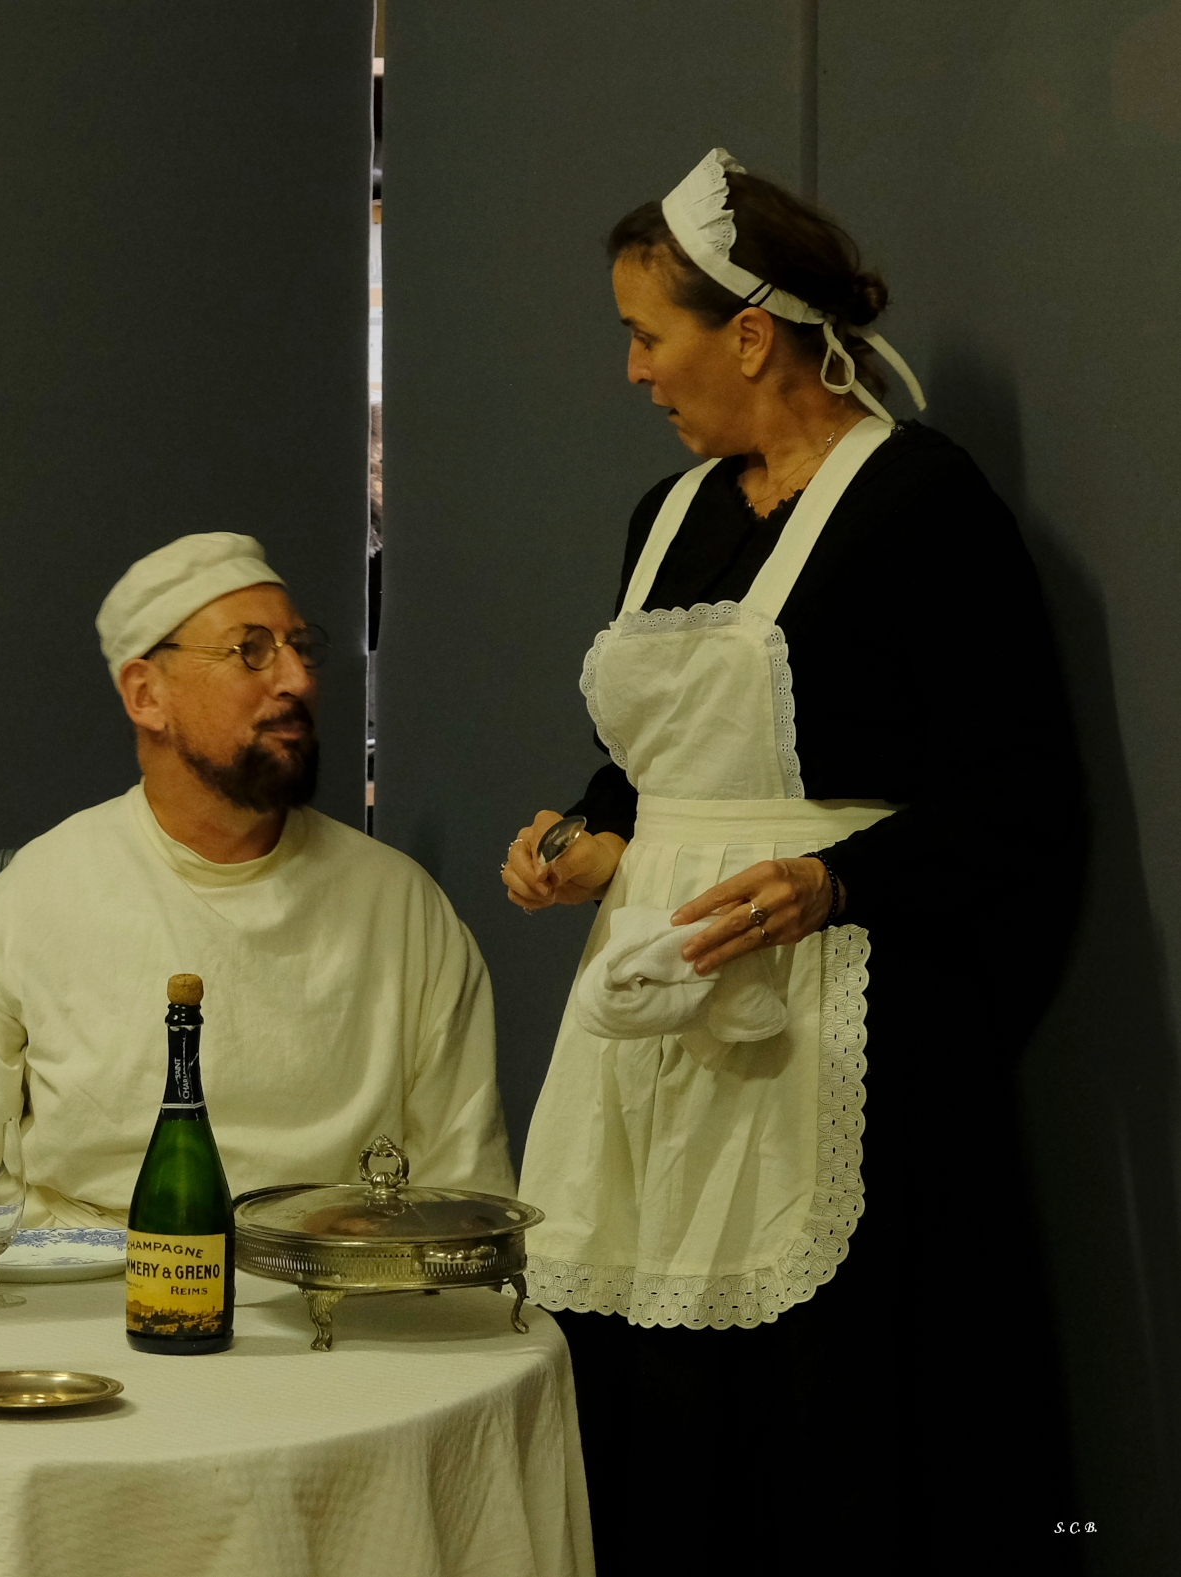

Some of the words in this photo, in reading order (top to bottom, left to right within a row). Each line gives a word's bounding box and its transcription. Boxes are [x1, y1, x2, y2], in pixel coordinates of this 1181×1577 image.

[127, 1241, 204, 1259] CHAMPAGNE
[162, 1267, 172, 1280] &
[175, 1264, 220, 1280] GRENO
